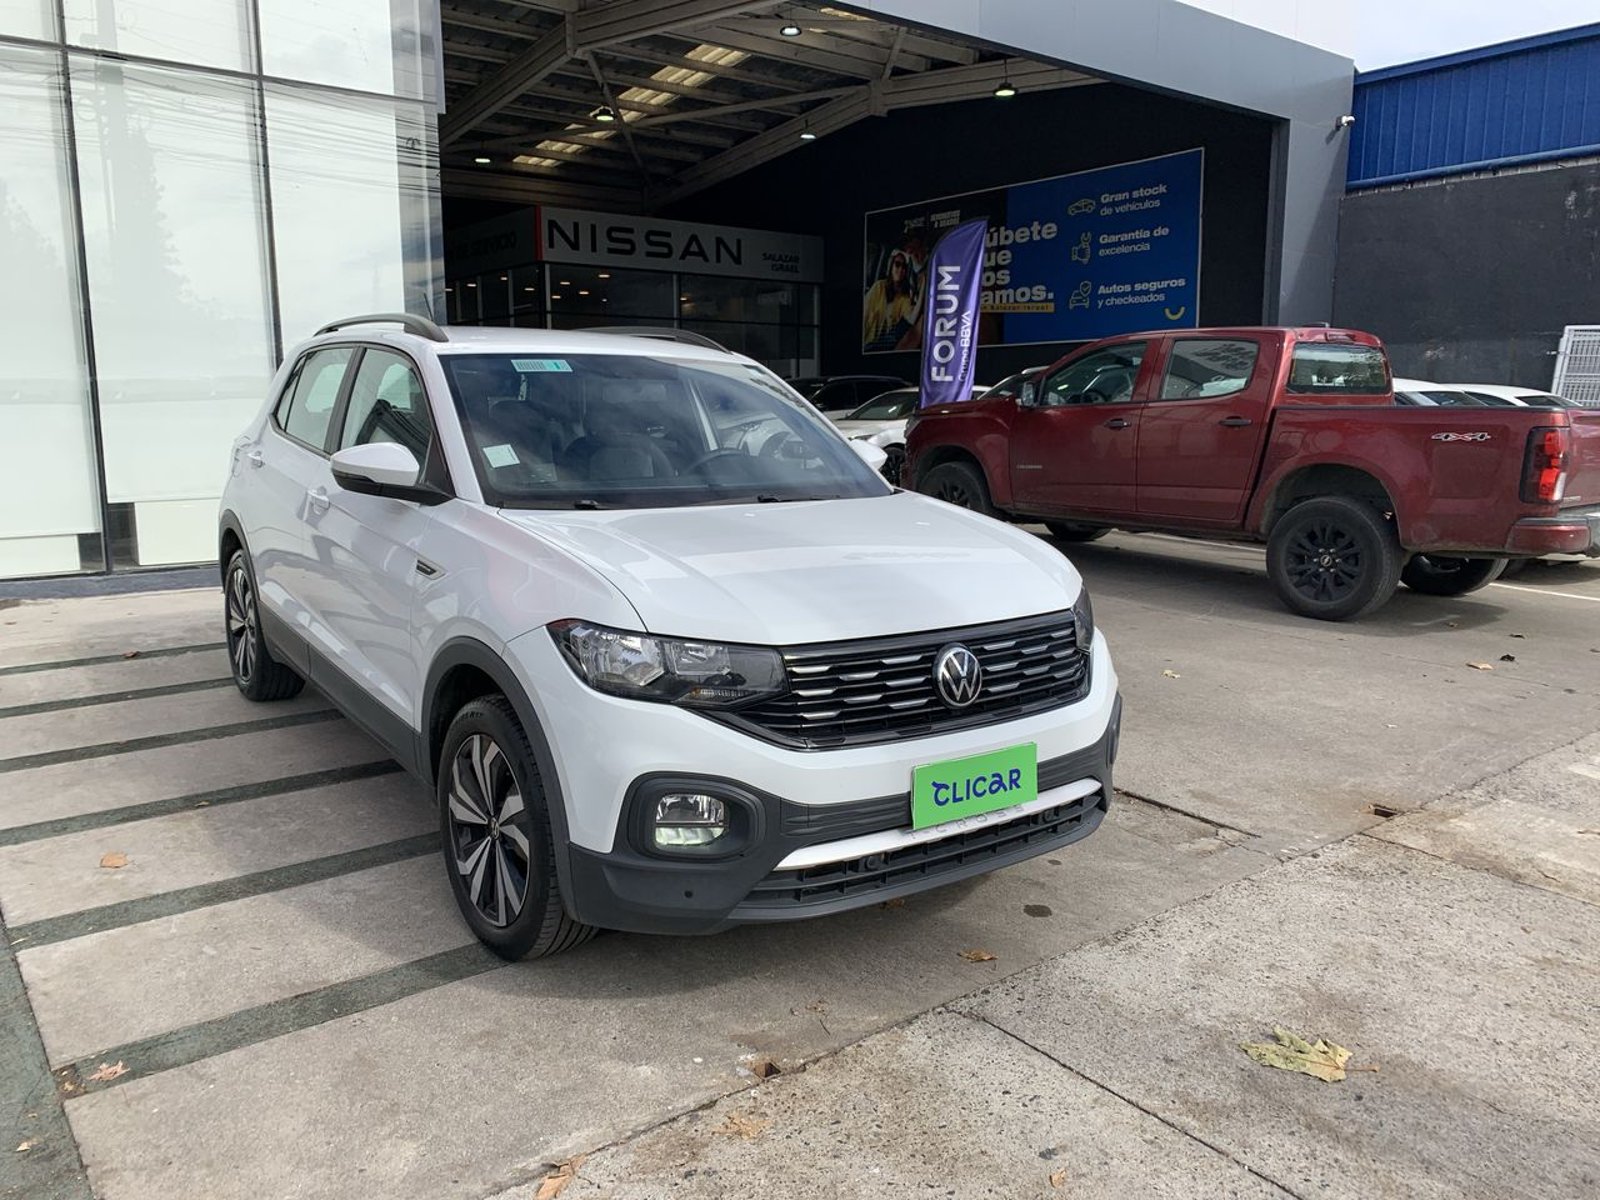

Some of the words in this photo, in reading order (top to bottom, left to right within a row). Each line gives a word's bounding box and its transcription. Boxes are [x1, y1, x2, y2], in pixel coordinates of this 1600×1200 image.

[1100, 191, 1130, 203] Gran
[1132, 184, 1168, 198] stock
[1099, 206, 1113, 216] de
[1115, 199, 1161, 214] vehículos
[547, 218, 743, 266] NISSAN
[985, 221, 1058, 248] úbete
[1099, 228, 1151, 244] Garantía
[1153, 226, 1170, 237] de
[982, 249, 1013, 268] ue
[1098, 242, 1151, 257] excelencia
[981, 269, 1011, 287] os
[1097, 283, 1131, 295] Autos
[1134, 278, 1186, 292] seguros
[980, 285, 1055, 305] amos.
[1097, 299, 1104, 310] y
[1105, 292, 1166, 306] checkeados
[931, 265, 961, 382] FORUM
[960, 311, 972, 347] BBVA
